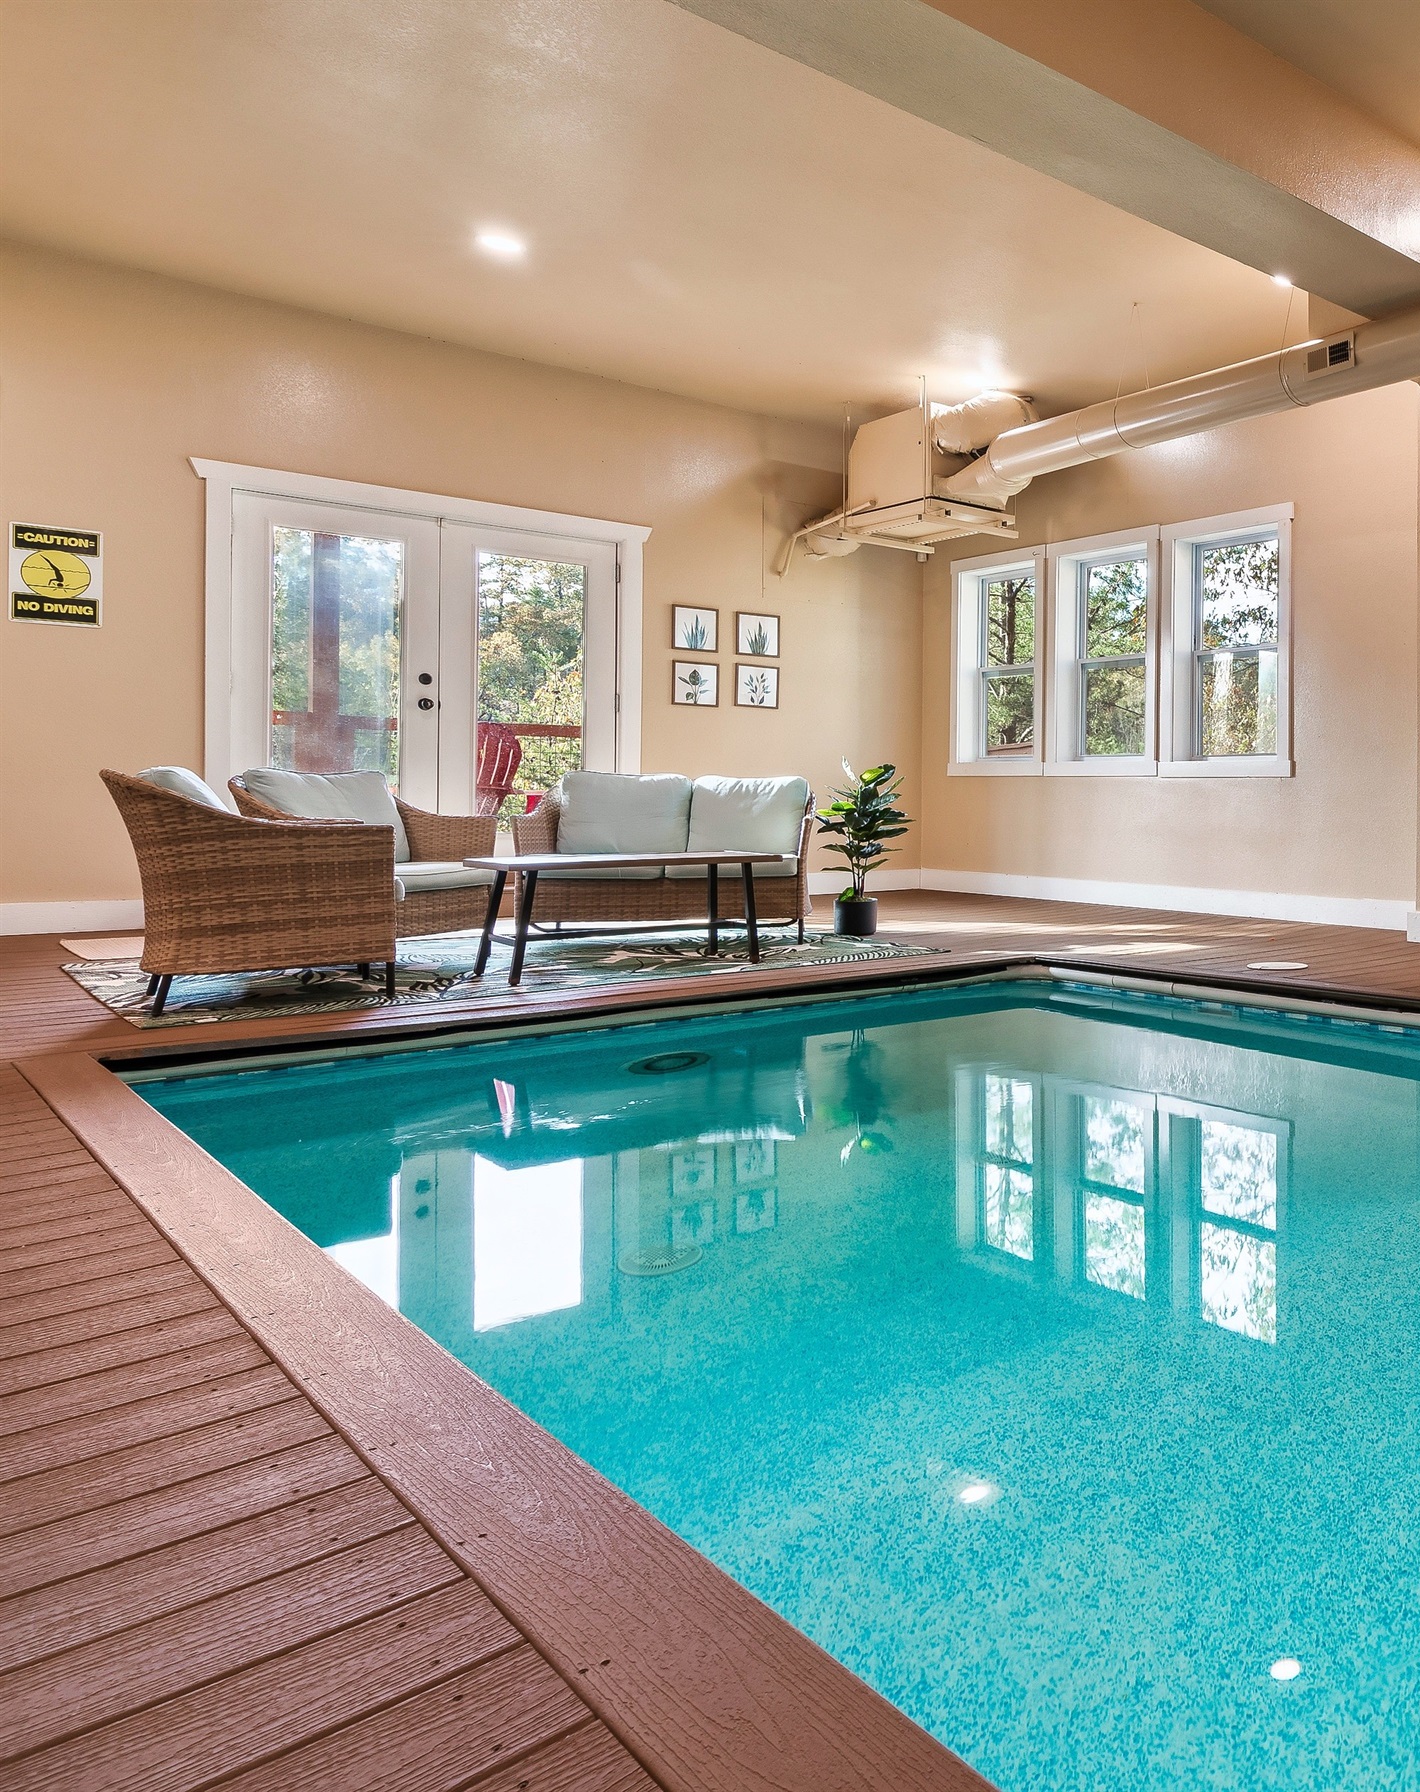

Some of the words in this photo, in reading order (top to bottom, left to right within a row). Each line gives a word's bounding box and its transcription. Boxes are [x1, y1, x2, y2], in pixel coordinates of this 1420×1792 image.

[23, 532, 89, 548] CAUTION
[17, 600, 40, 611] NO
[43, 603, 94, 616] DIVING
